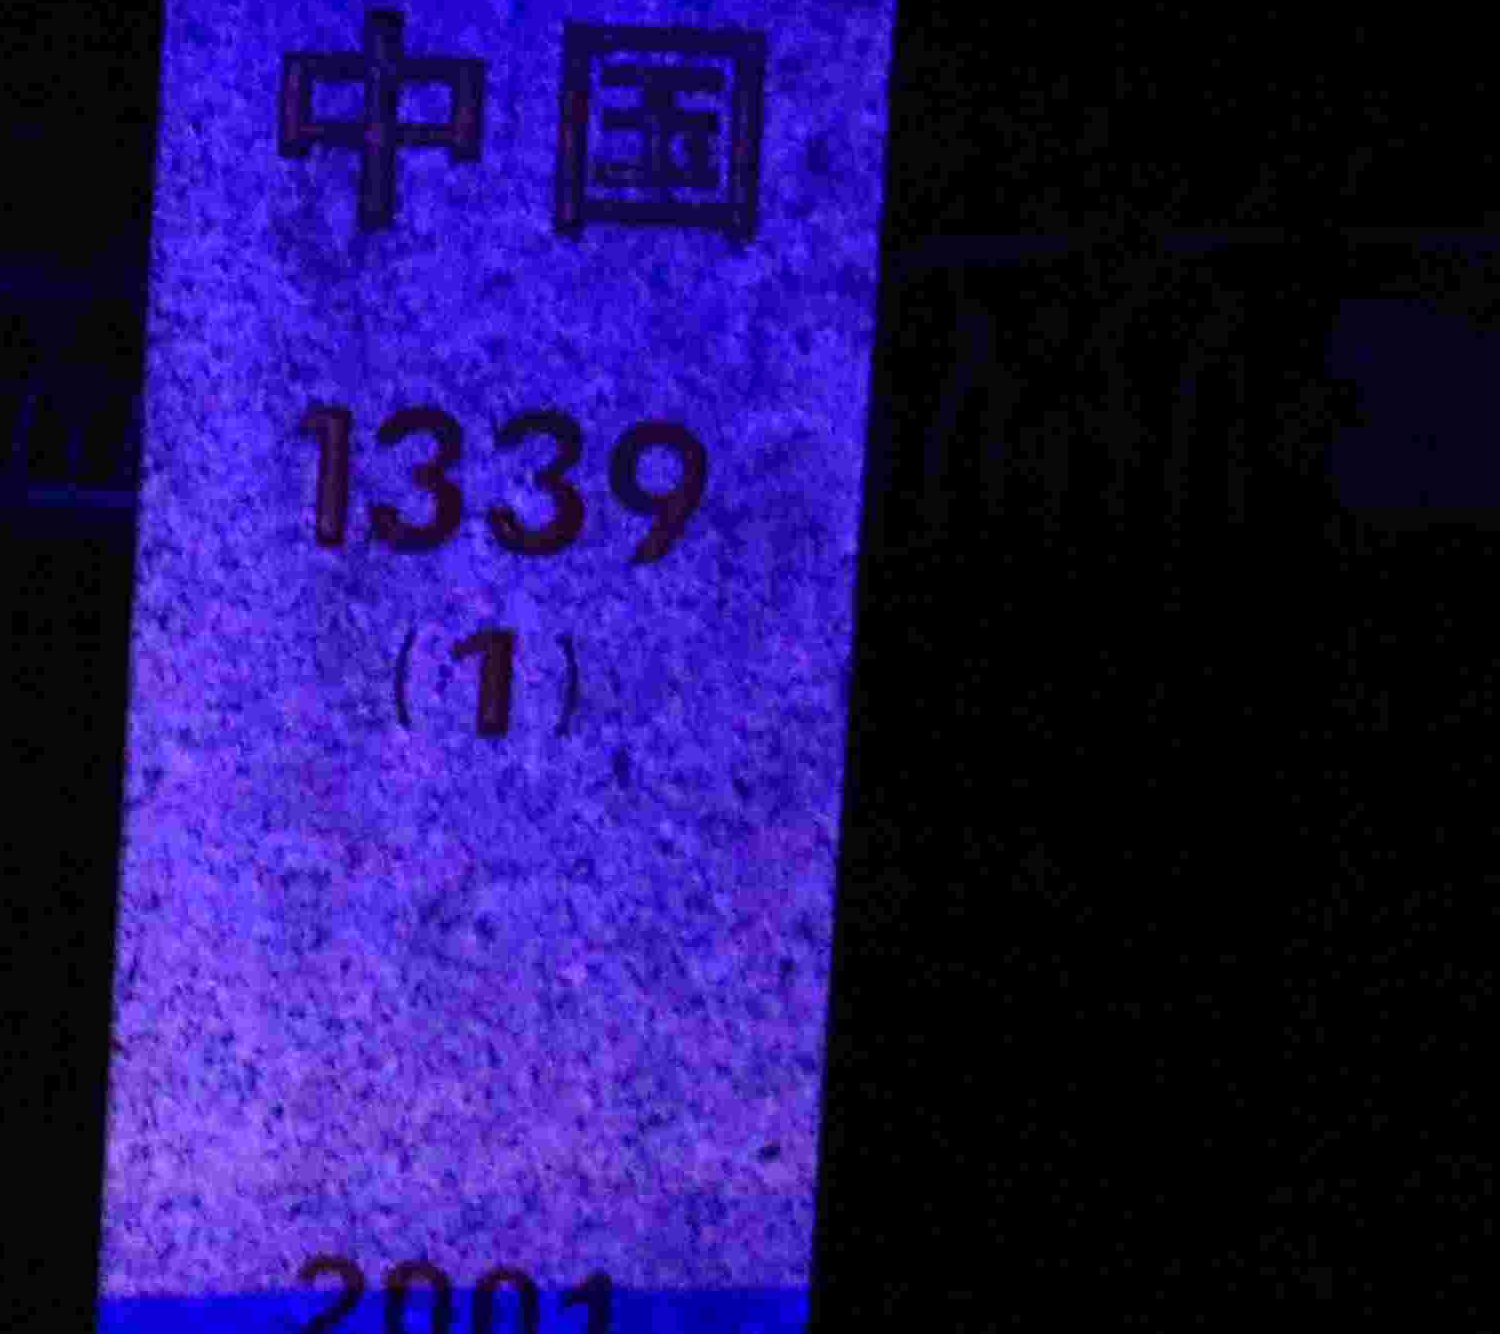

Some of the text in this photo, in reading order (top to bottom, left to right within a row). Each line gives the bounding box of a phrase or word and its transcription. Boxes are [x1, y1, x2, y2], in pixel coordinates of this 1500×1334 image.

[276, 8, 766, 244] 中国
[300, 404, 708, 564] 1339
[395, 627, 580, 738] (1)
